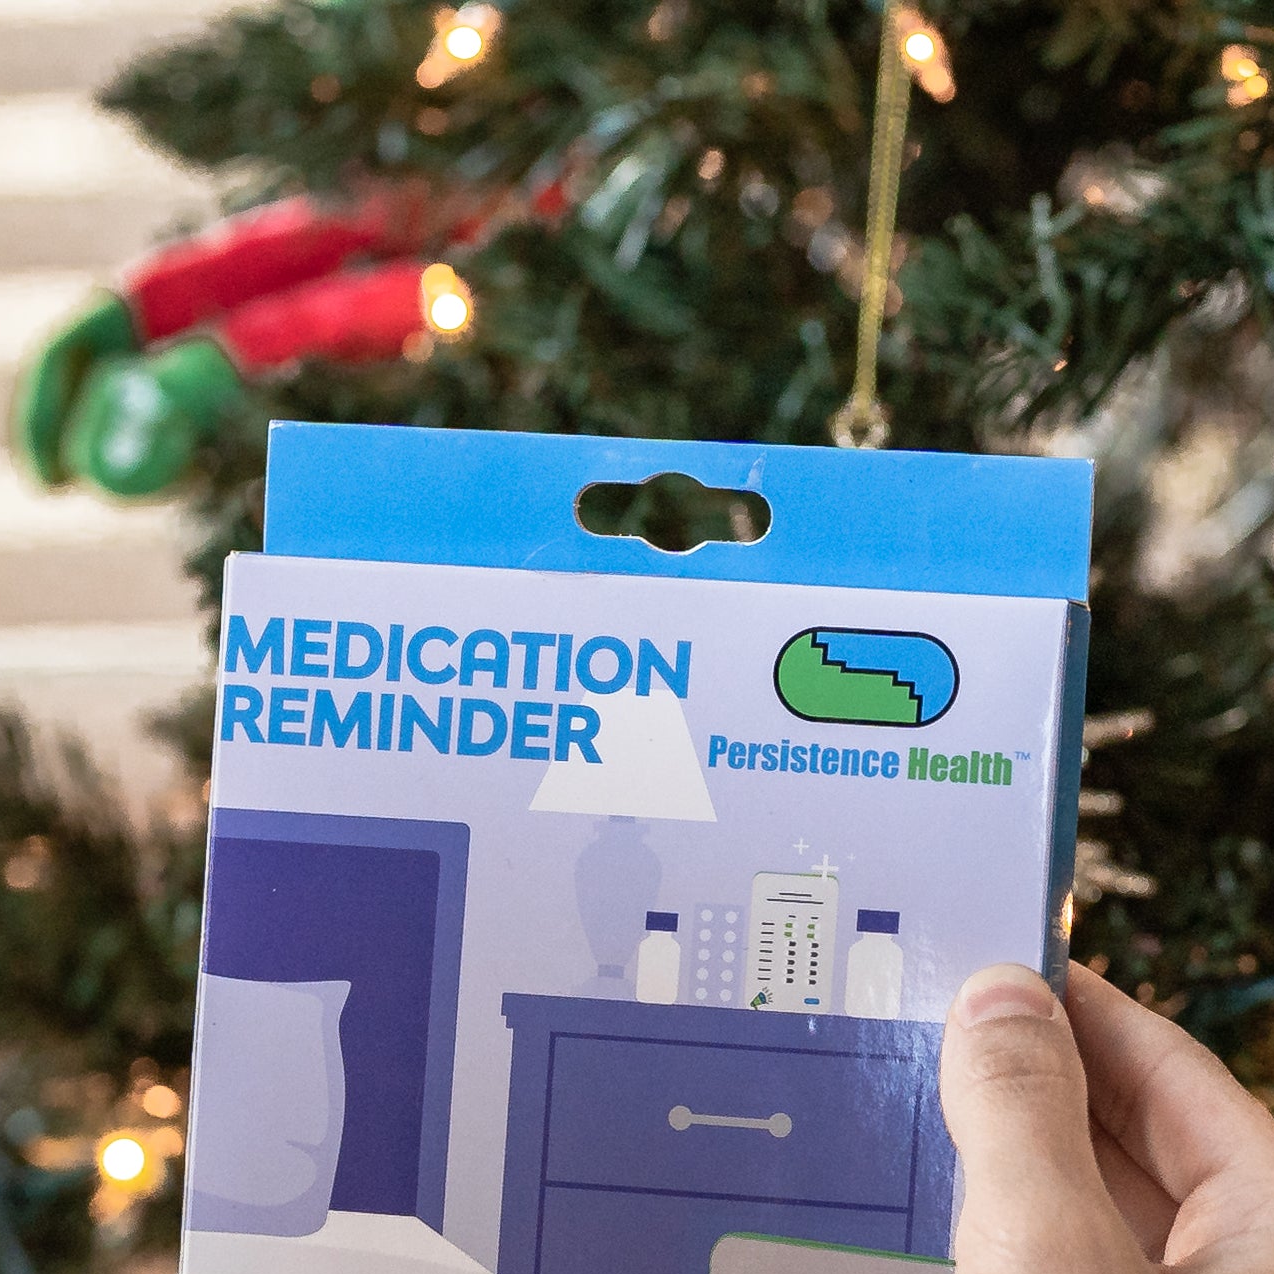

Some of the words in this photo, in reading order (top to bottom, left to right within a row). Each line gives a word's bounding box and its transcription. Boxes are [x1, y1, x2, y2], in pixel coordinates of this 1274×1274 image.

[223, 614, 693, 699] MEDICATION
[220, 683, 604, 764] REMINDER
[707, 734, 900, 779] Persistence
